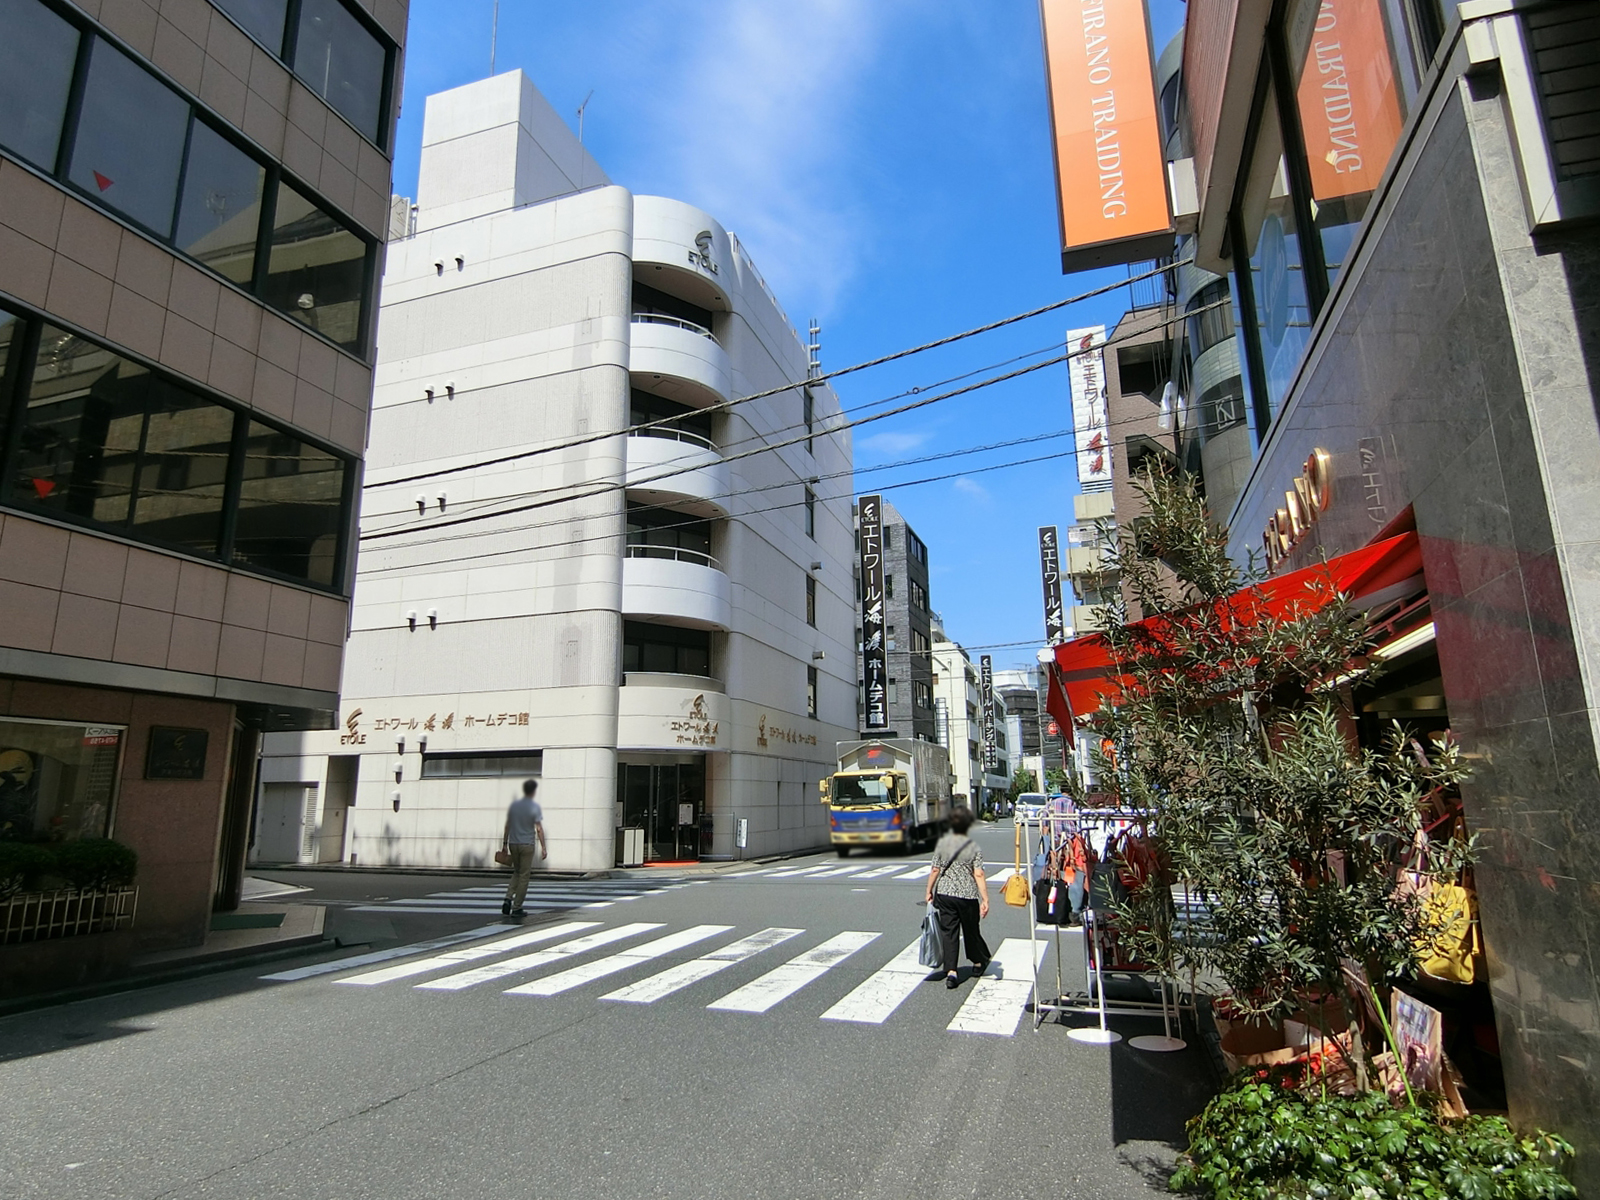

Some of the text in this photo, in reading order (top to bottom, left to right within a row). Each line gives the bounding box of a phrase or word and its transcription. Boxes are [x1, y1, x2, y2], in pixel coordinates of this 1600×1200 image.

[1091, 89, 1127, 219] TRAIDING
[868, 658, 884, 725] ホームデコ館
[340, 734, 367, 745] ETOILE
[464, 712, 530, 728] ホームデコ館
